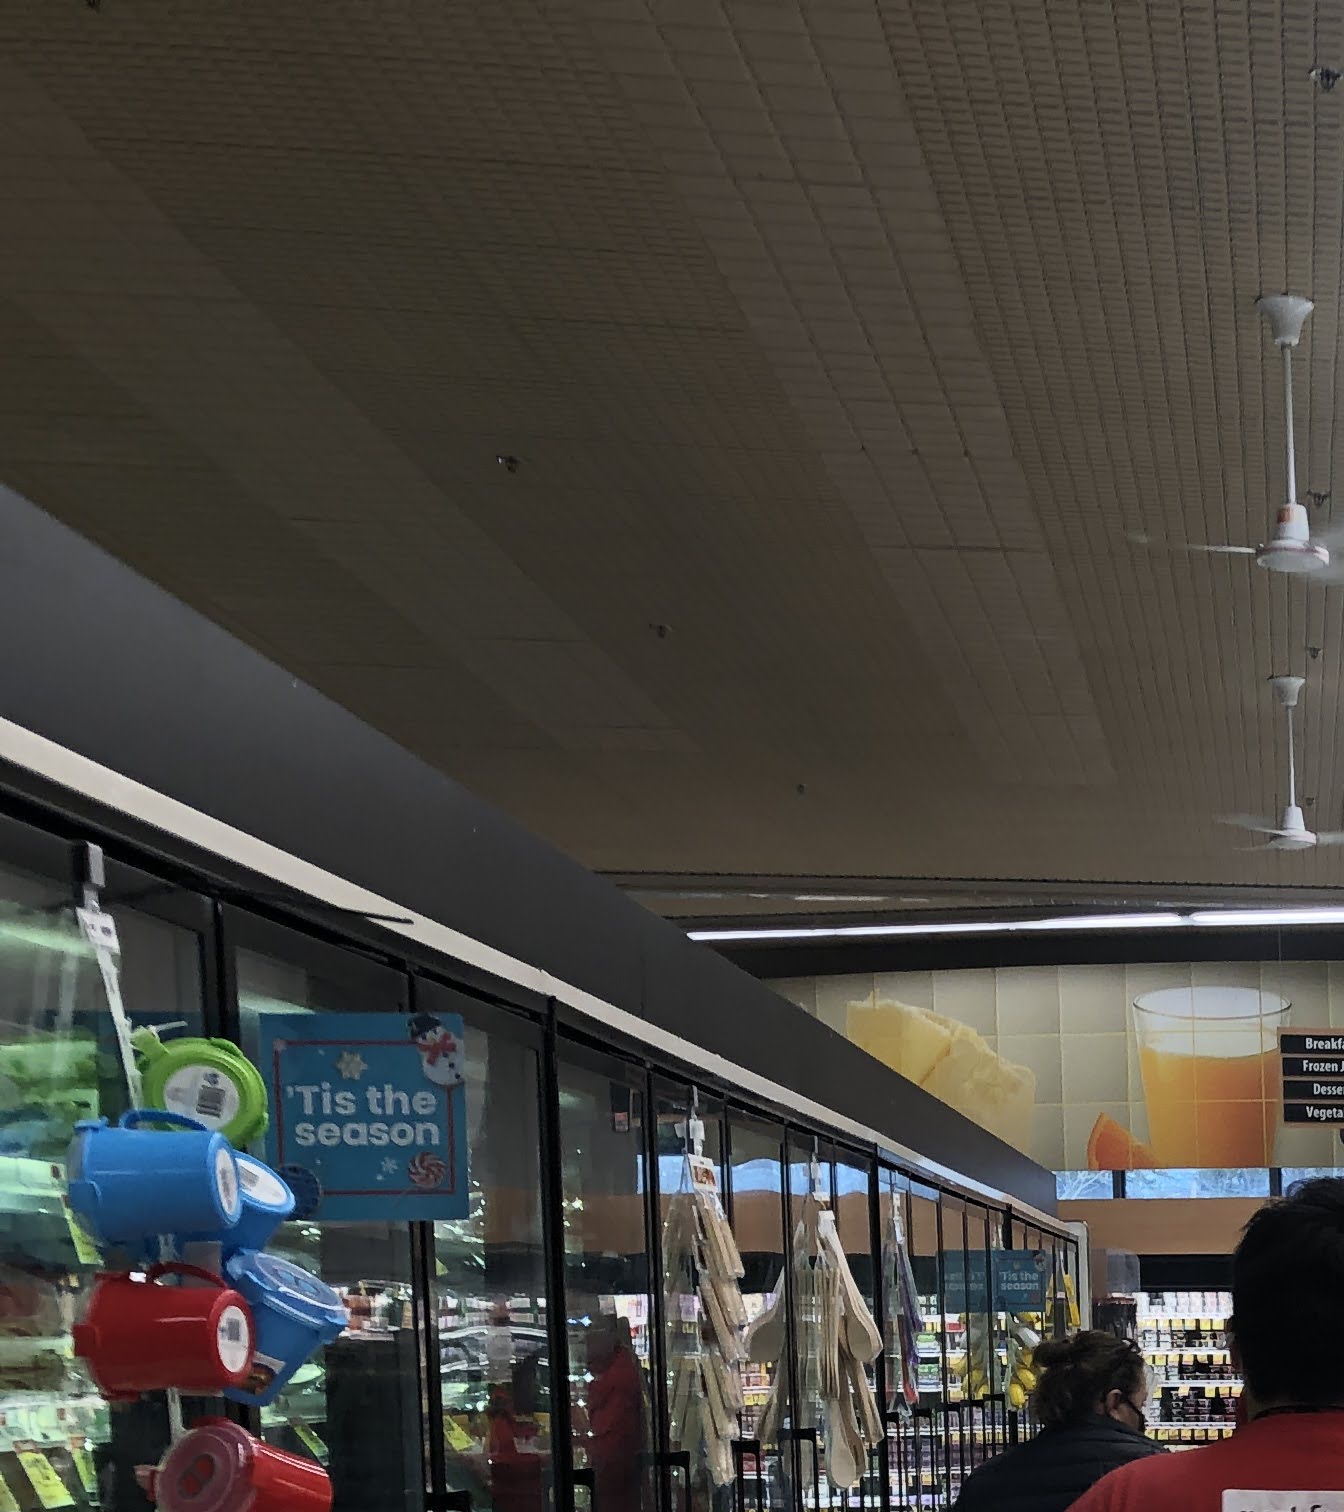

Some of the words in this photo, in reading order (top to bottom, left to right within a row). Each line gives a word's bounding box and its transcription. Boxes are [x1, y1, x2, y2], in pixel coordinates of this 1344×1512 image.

[1302, 1060, 1338, 1073] Frozen
[287, 1082, 356, 1115] 'Tis
[365, 1084, 437, 1116] the
[294, 1121, 440, 1148] season
[1020, 1271, 1039, 1280] the
[1000, 1282, 1039, 1290] season
